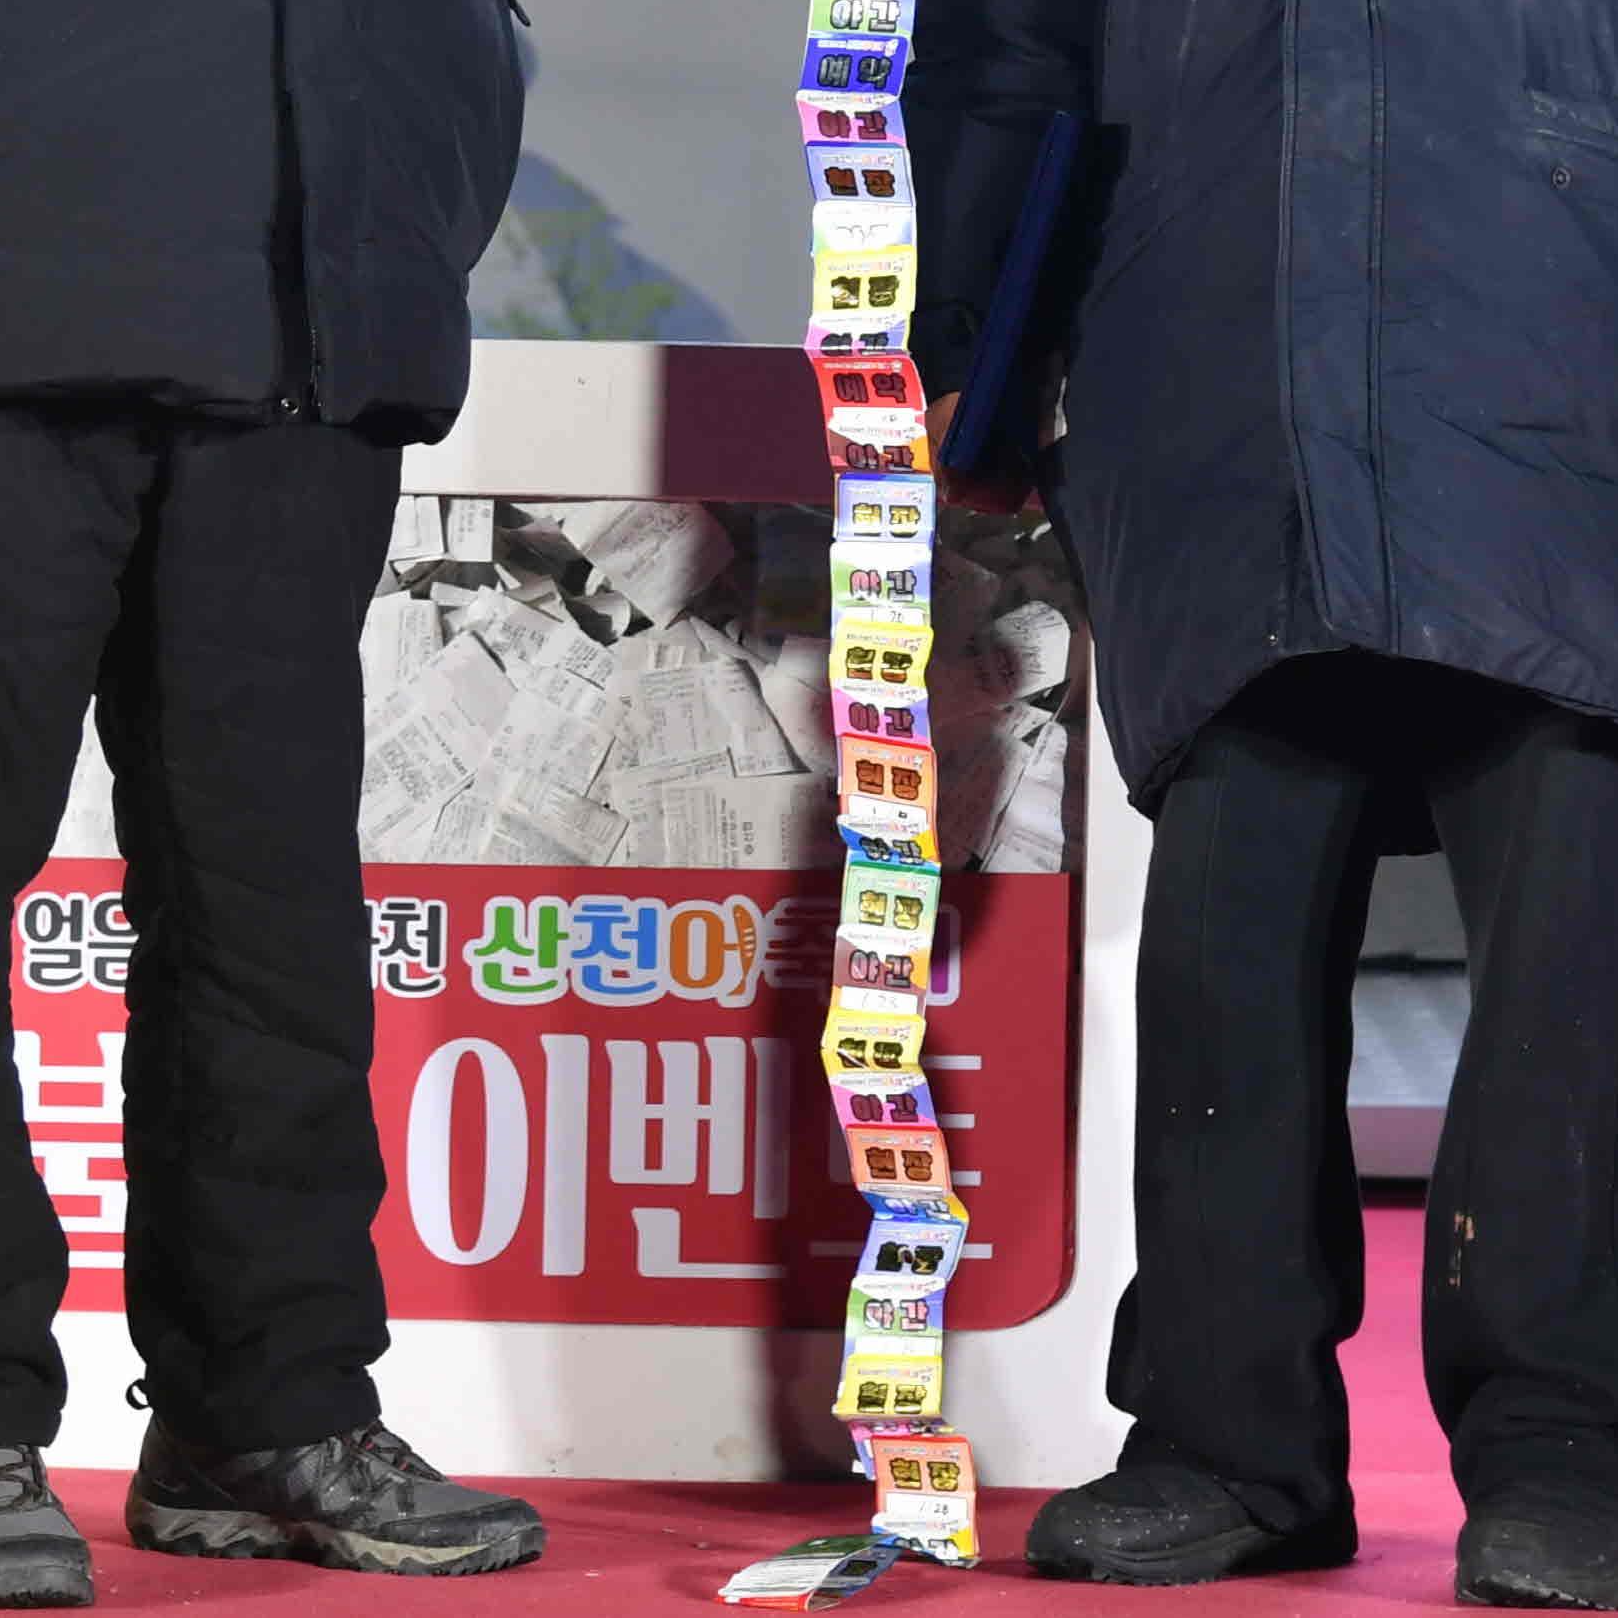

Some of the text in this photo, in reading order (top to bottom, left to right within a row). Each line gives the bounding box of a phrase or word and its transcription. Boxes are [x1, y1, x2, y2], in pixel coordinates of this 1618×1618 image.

[817, 53, 893, 89] 예약
[817, 109, 887, 141] 야간
[848, 702, 915, 739] 야간
[855, 759, 922, 801] 현장
[849, 949, 915, 988] 야간
[849, 1093, 919, 1123] 야간
[864, 1146, 934, 1182] 현장
[864, 1299, 930, 1332] 야간
[889, 1457, 962, 1492] 현장
